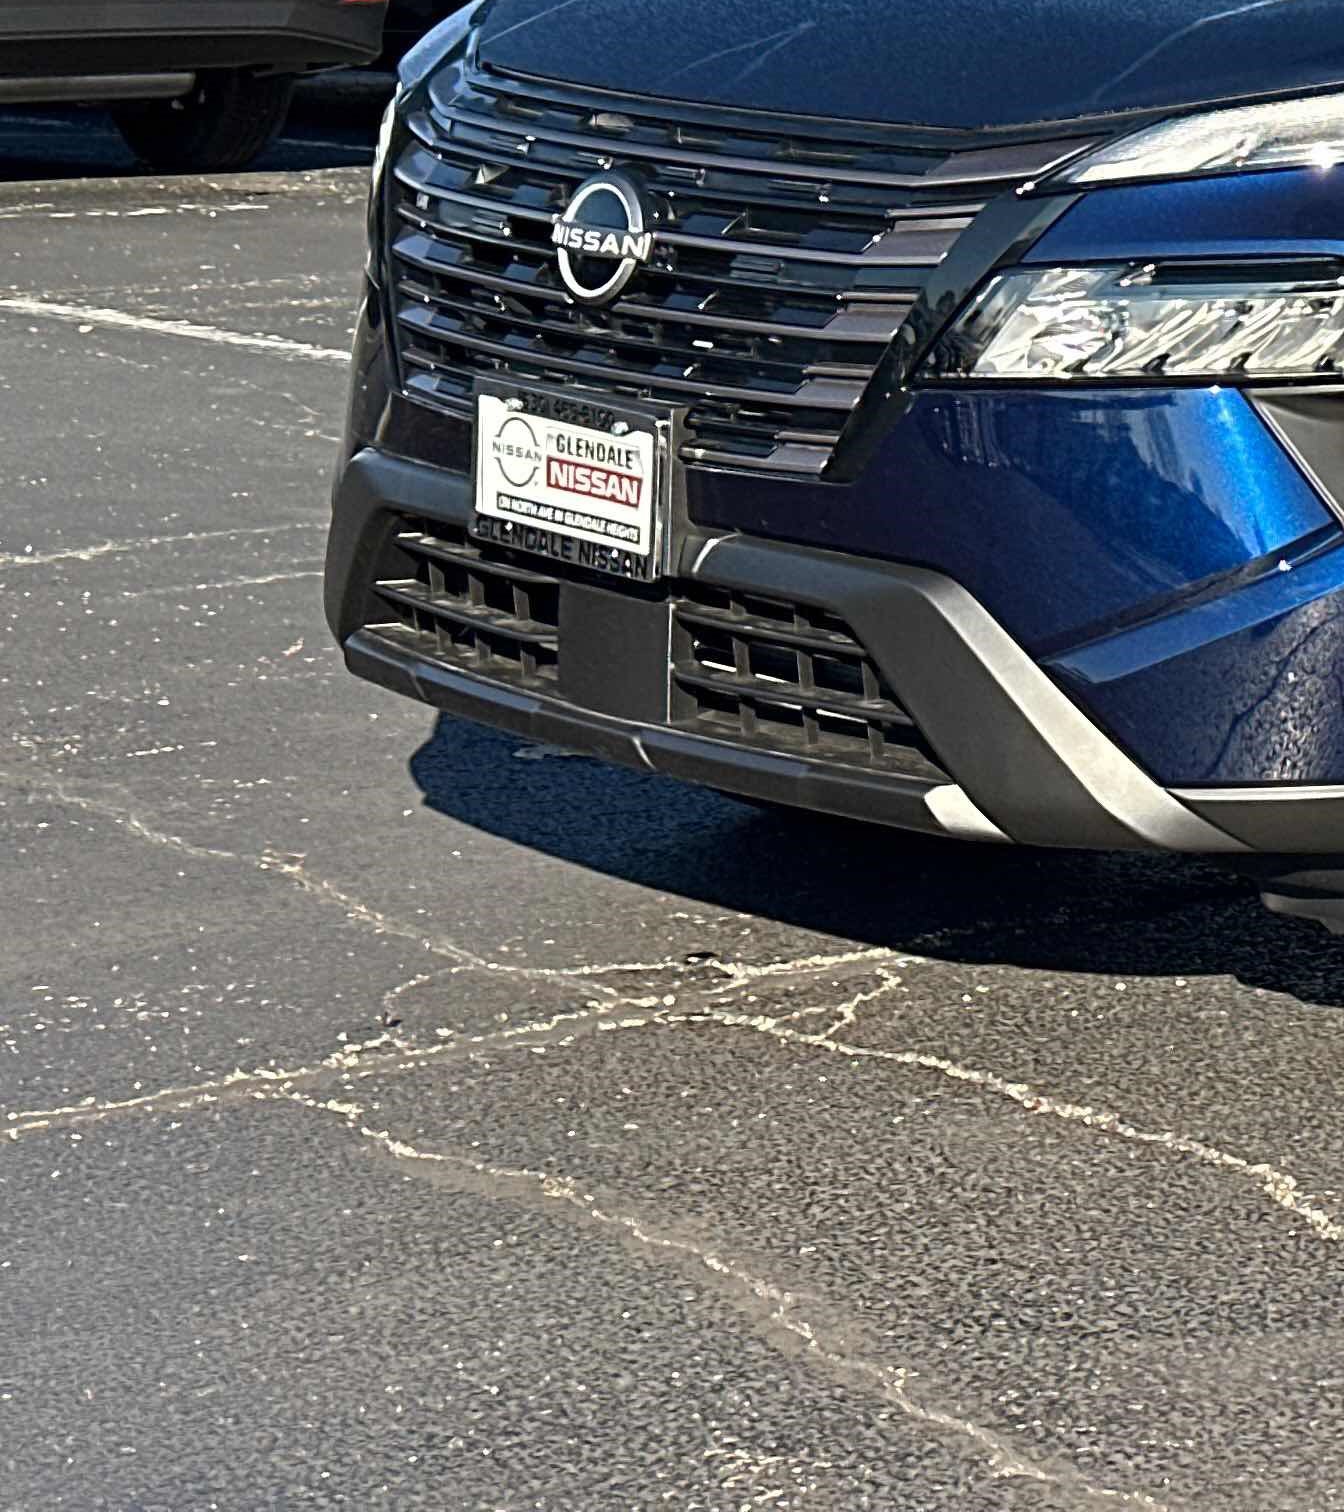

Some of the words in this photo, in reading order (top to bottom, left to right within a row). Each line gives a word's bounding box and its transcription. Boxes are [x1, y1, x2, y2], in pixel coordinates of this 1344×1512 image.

[551, 222, 651, 261] NISSAN
[492, 440, 543, 463] NISSAN
[556, 433, 633, 470] GLENDALE
[549, 460, 639, 505] NISSAN
